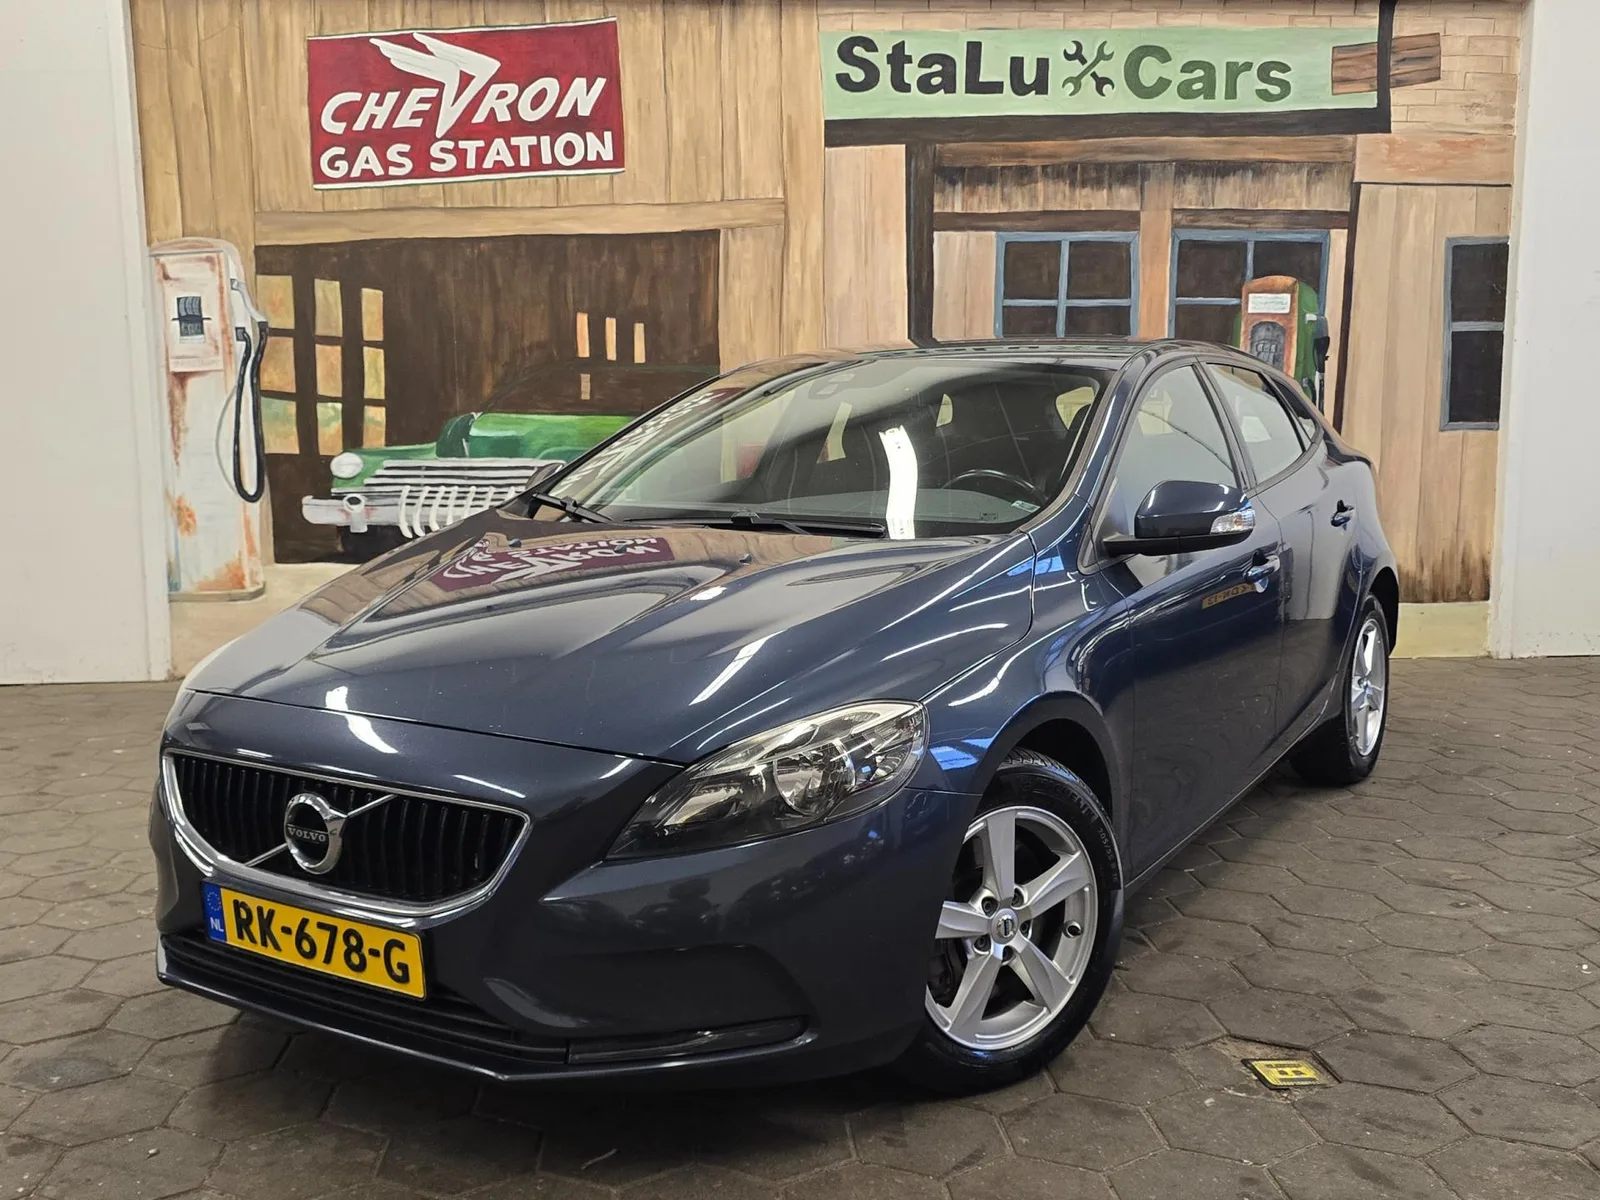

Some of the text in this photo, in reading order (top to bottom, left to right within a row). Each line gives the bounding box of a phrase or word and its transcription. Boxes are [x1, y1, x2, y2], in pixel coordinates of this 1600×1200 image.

[835, 35, 1292, 103] StaLu Cars
[320, 77, 607, 139] CHEVRON
[319, 130, 614, 179] GAS STATION
[287, 827, 327, 842] VOLVO
[210, 916, 225, 933] NL
[232, 898, 410, 985] RK-678-G
